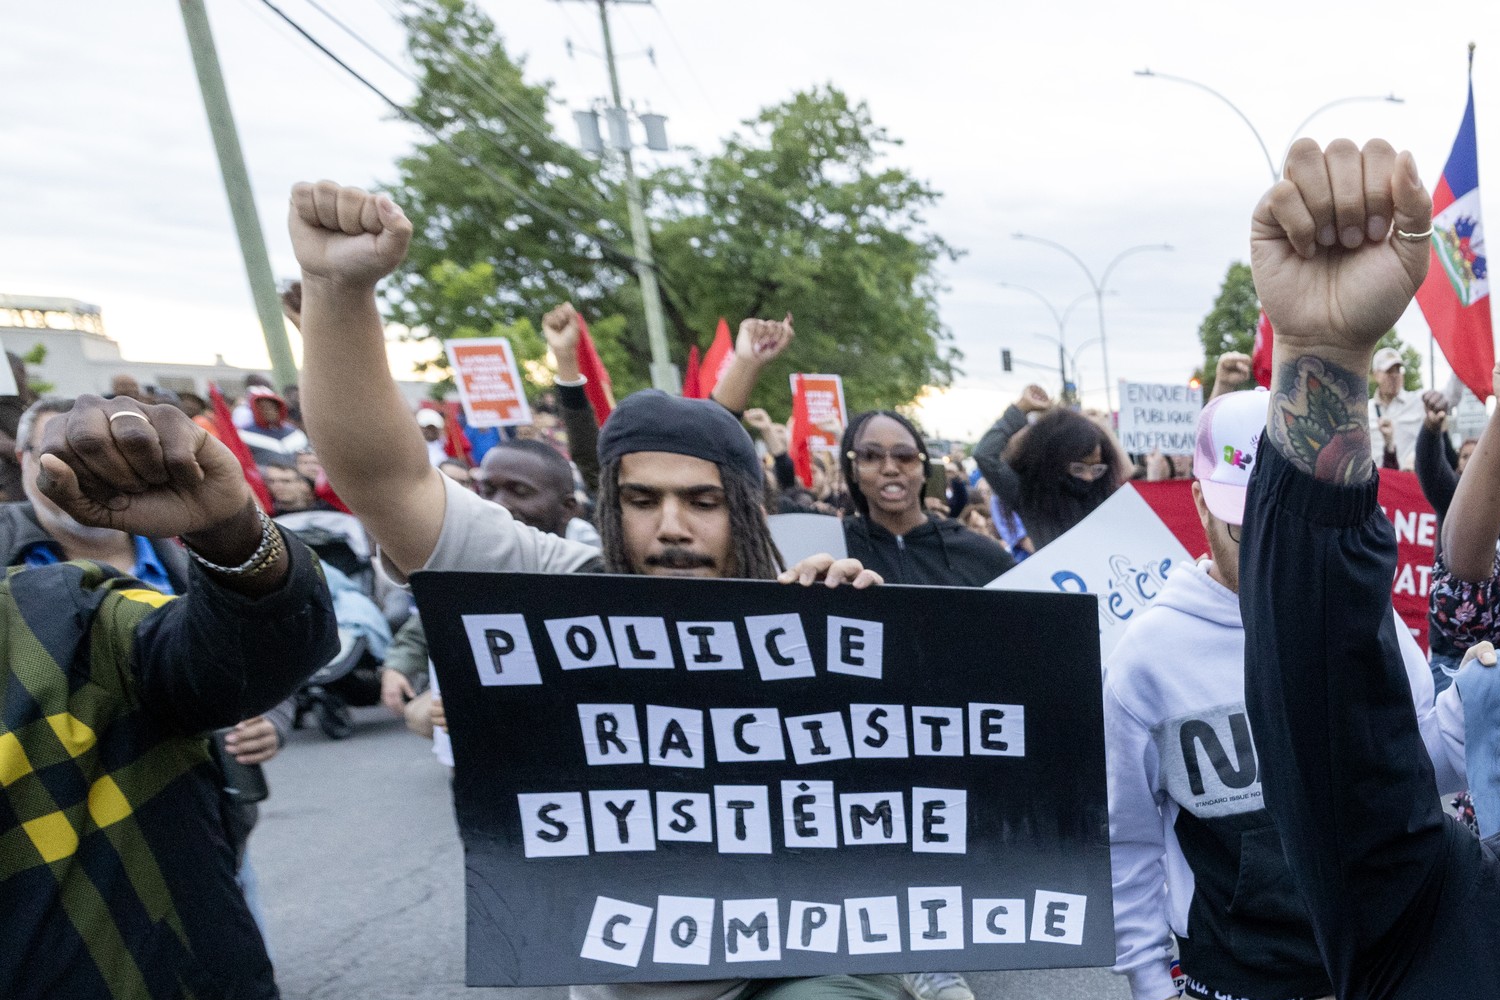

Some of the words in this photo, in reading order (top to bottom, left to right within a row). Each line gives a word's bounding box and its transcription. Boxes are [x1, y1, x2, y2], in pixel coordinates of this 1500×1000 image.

[1134, 406, 1193, 424] PUBLIQUE
[485, 622, 866, 675] POLICE
[596, 707, 1009, 760] RACISTE
[1194, 797, 1228, 808] STANDARD
[1229, 793, 1249, 802] ISSUE
[602, 898, 1068, 955] COMPLICE
